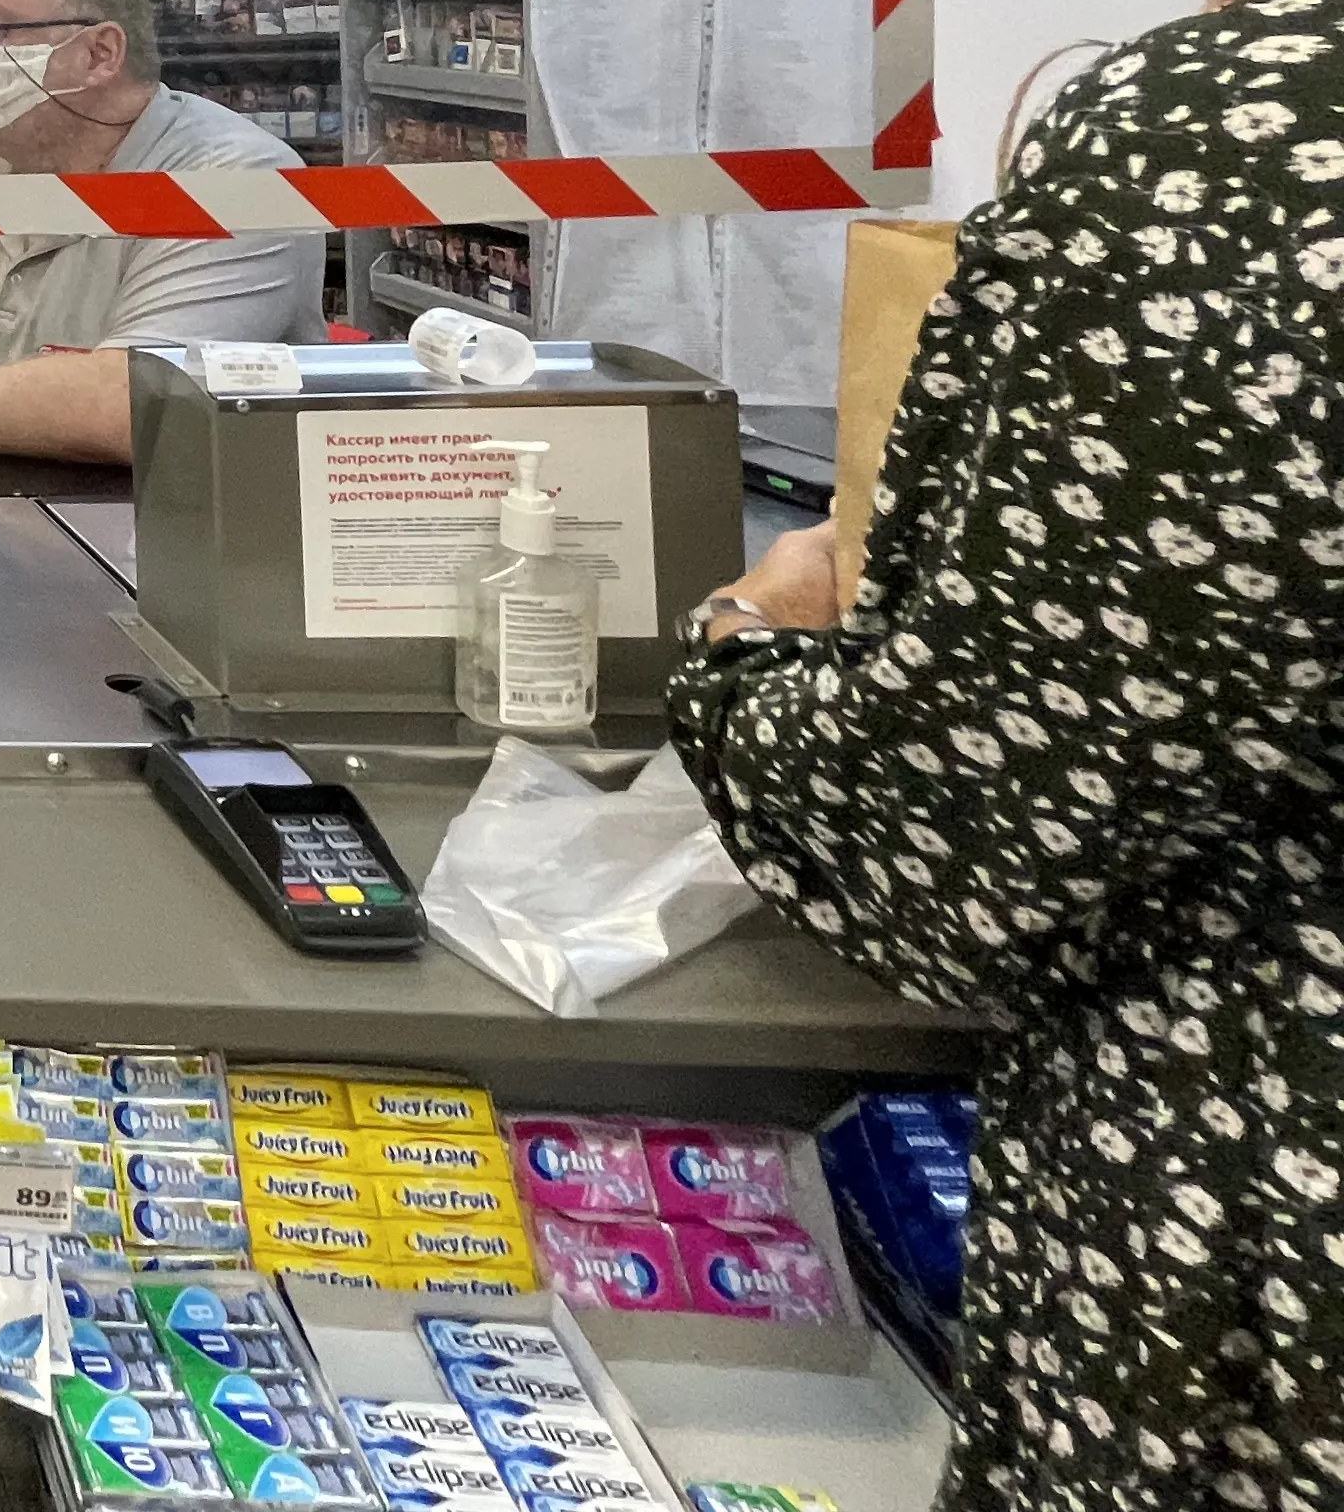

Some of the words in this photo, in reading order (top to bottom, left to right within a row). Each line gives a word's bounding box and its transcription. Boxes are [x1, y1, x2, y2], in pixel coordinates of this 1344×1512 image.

[326, 434, 384, 449] Кассир
[389, 434, 437, 445] имеет
[327, 453, 413, 467] попросить
[328, 471, 426, 485] предъявить
[431, 470, 515, 484] документ,
[329, 487, 473, 504] удостоверяющий
[115, 1060, 174, 1088] Orbit
[239, 1085, 281, 1106] Juicy
[284, 1087, 328, 1107] Fruit
[377, 1095, 420, 1117] Juicy
[423, 1098, 470, 1119] Fruit
[120, 1106, 181, 1134] Orbit
[252, 1130, 298, 1153] Juicy
[300, 1135, 346, 1158] Fruit
[135, 1156, 196, 1186] Orbit
[678, 1155, 747, 1185] Orbit
[16, 1187, 51, 1207] 89
[264, 1174, 308, 1197] Juicy
[311, 1180, 356, 1202] Fruit
[401, 1188, 447, 1211] Juicy
[450, 1191, 497, 1212] Fruit
[141, 1204, 203, 1233] Orbit
[273, 1220, 320, 1243] Juicy
[322, 1226, 367, 1248] Fruit
[413, 1233, 459, 1255] Juicy
[462, 1236, 510, 1257] Fruit
[453, 1329, 559, 1357] eclipse
[473, 1369, 586, 1402] eclipse
[364, 1408, 473, 1439] eclipse
[502, 1417, 617, 1451] eclipse
[389, 1456, 500, 1489] eclipse
[531, 1469, 647, 1501] eclipse
